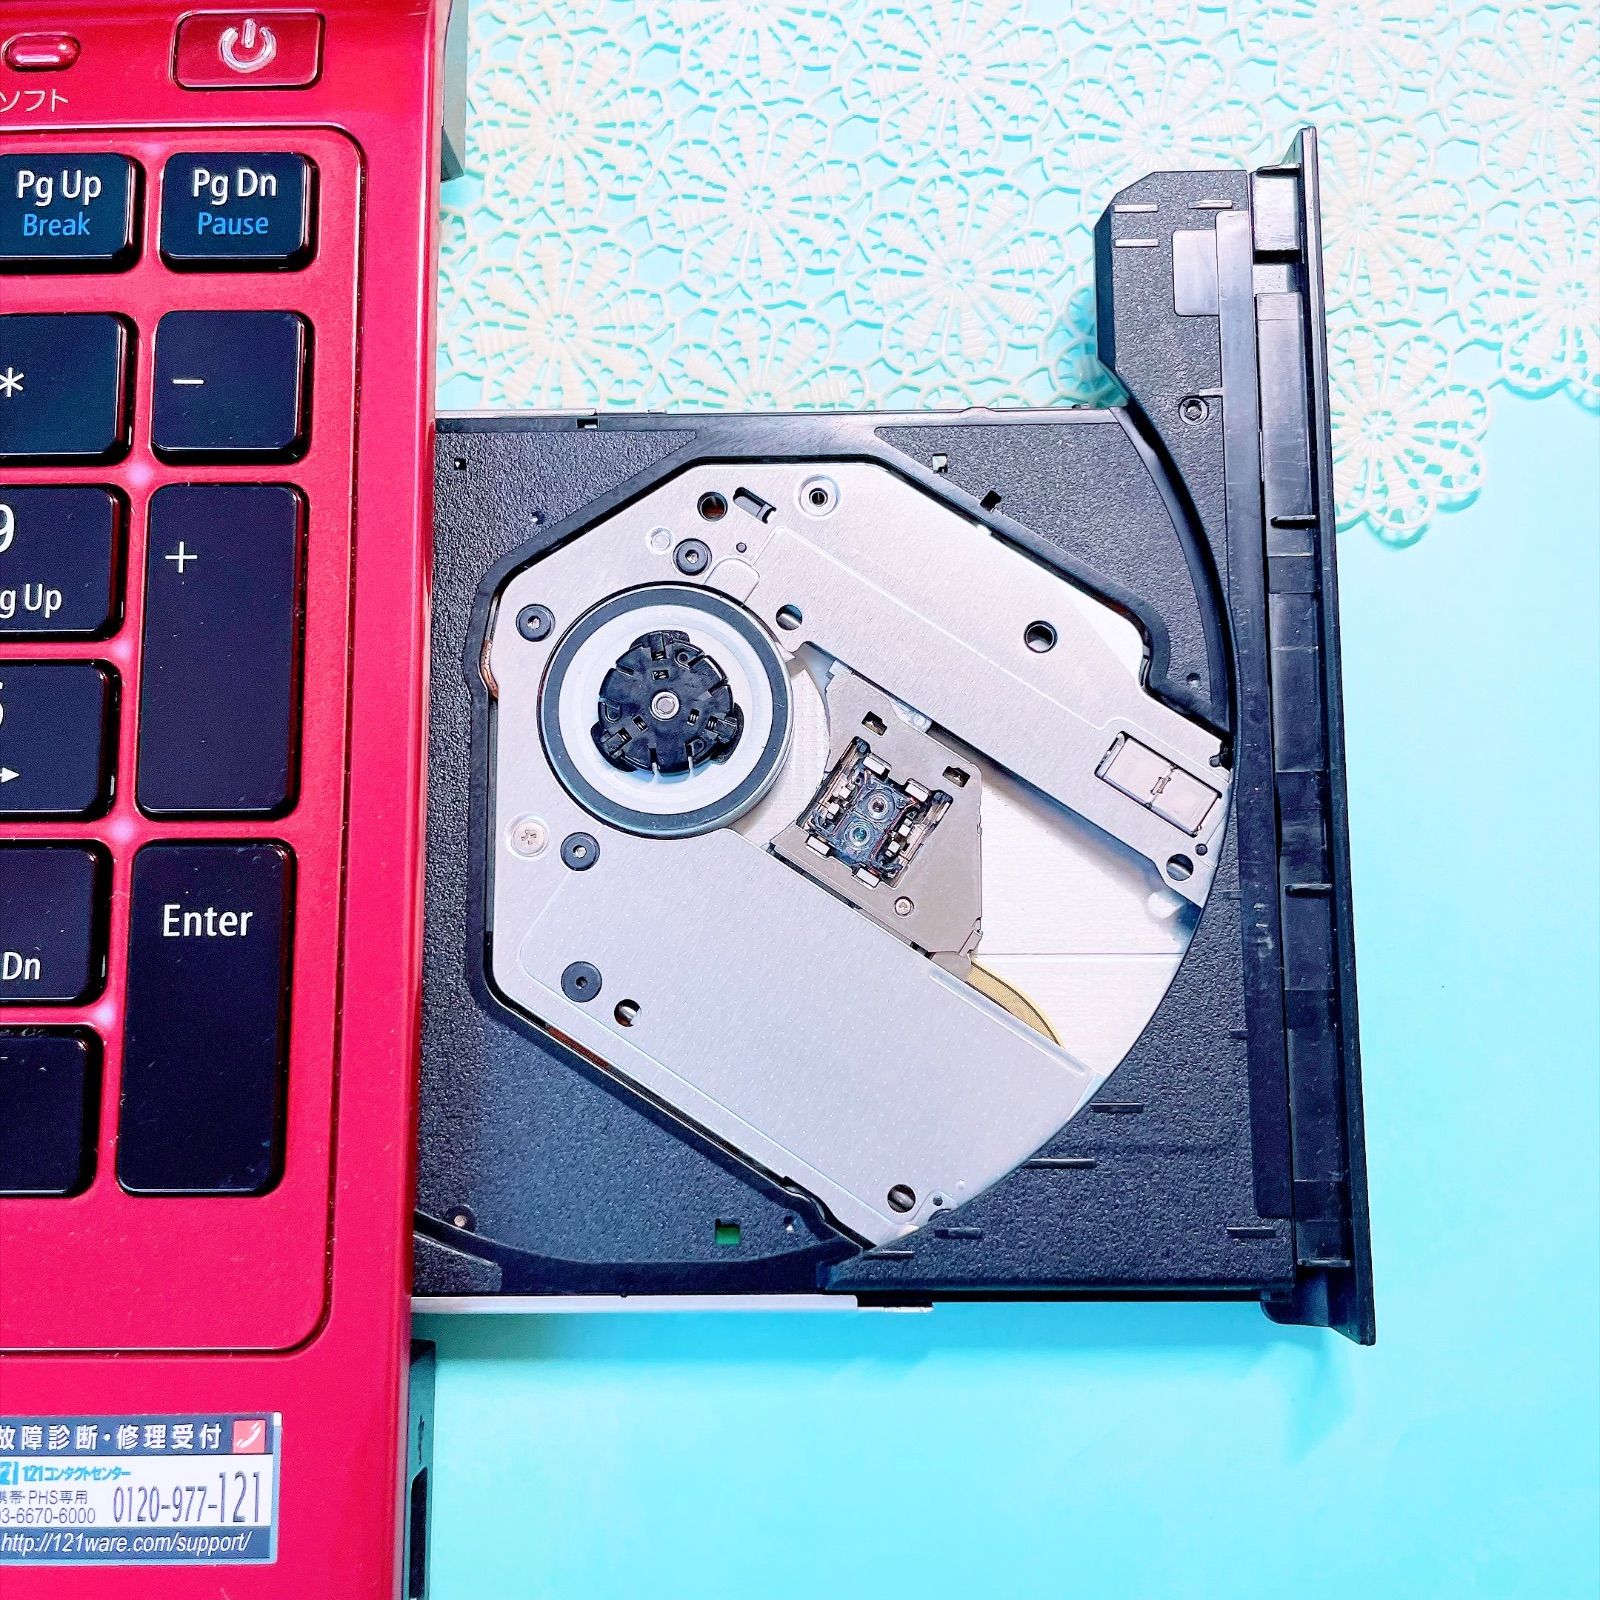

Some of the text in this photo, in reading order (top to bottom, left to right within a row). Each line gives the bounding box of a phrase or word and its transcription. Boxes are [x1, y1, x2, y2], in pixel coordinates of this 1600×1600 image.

[0, 88, 69, 113] ソフト
[17, 169, 102, 207] Pg Up
[192, 167, 277, 206] Pg Dn
[23, 212, 91, 237] Break
[197, 211, 269, 236] Pause
[23, 583, 62, 619] Up
[162, 904, 254, 937] Enter
[2, 951, 41, 981] Dn
[112, 1470, 261, 1523] 0120-977-121
[0, 1507, 96, 1524] 3-6670-6000
[2, 1531, 252, 1557] http://121ware.com/support/
